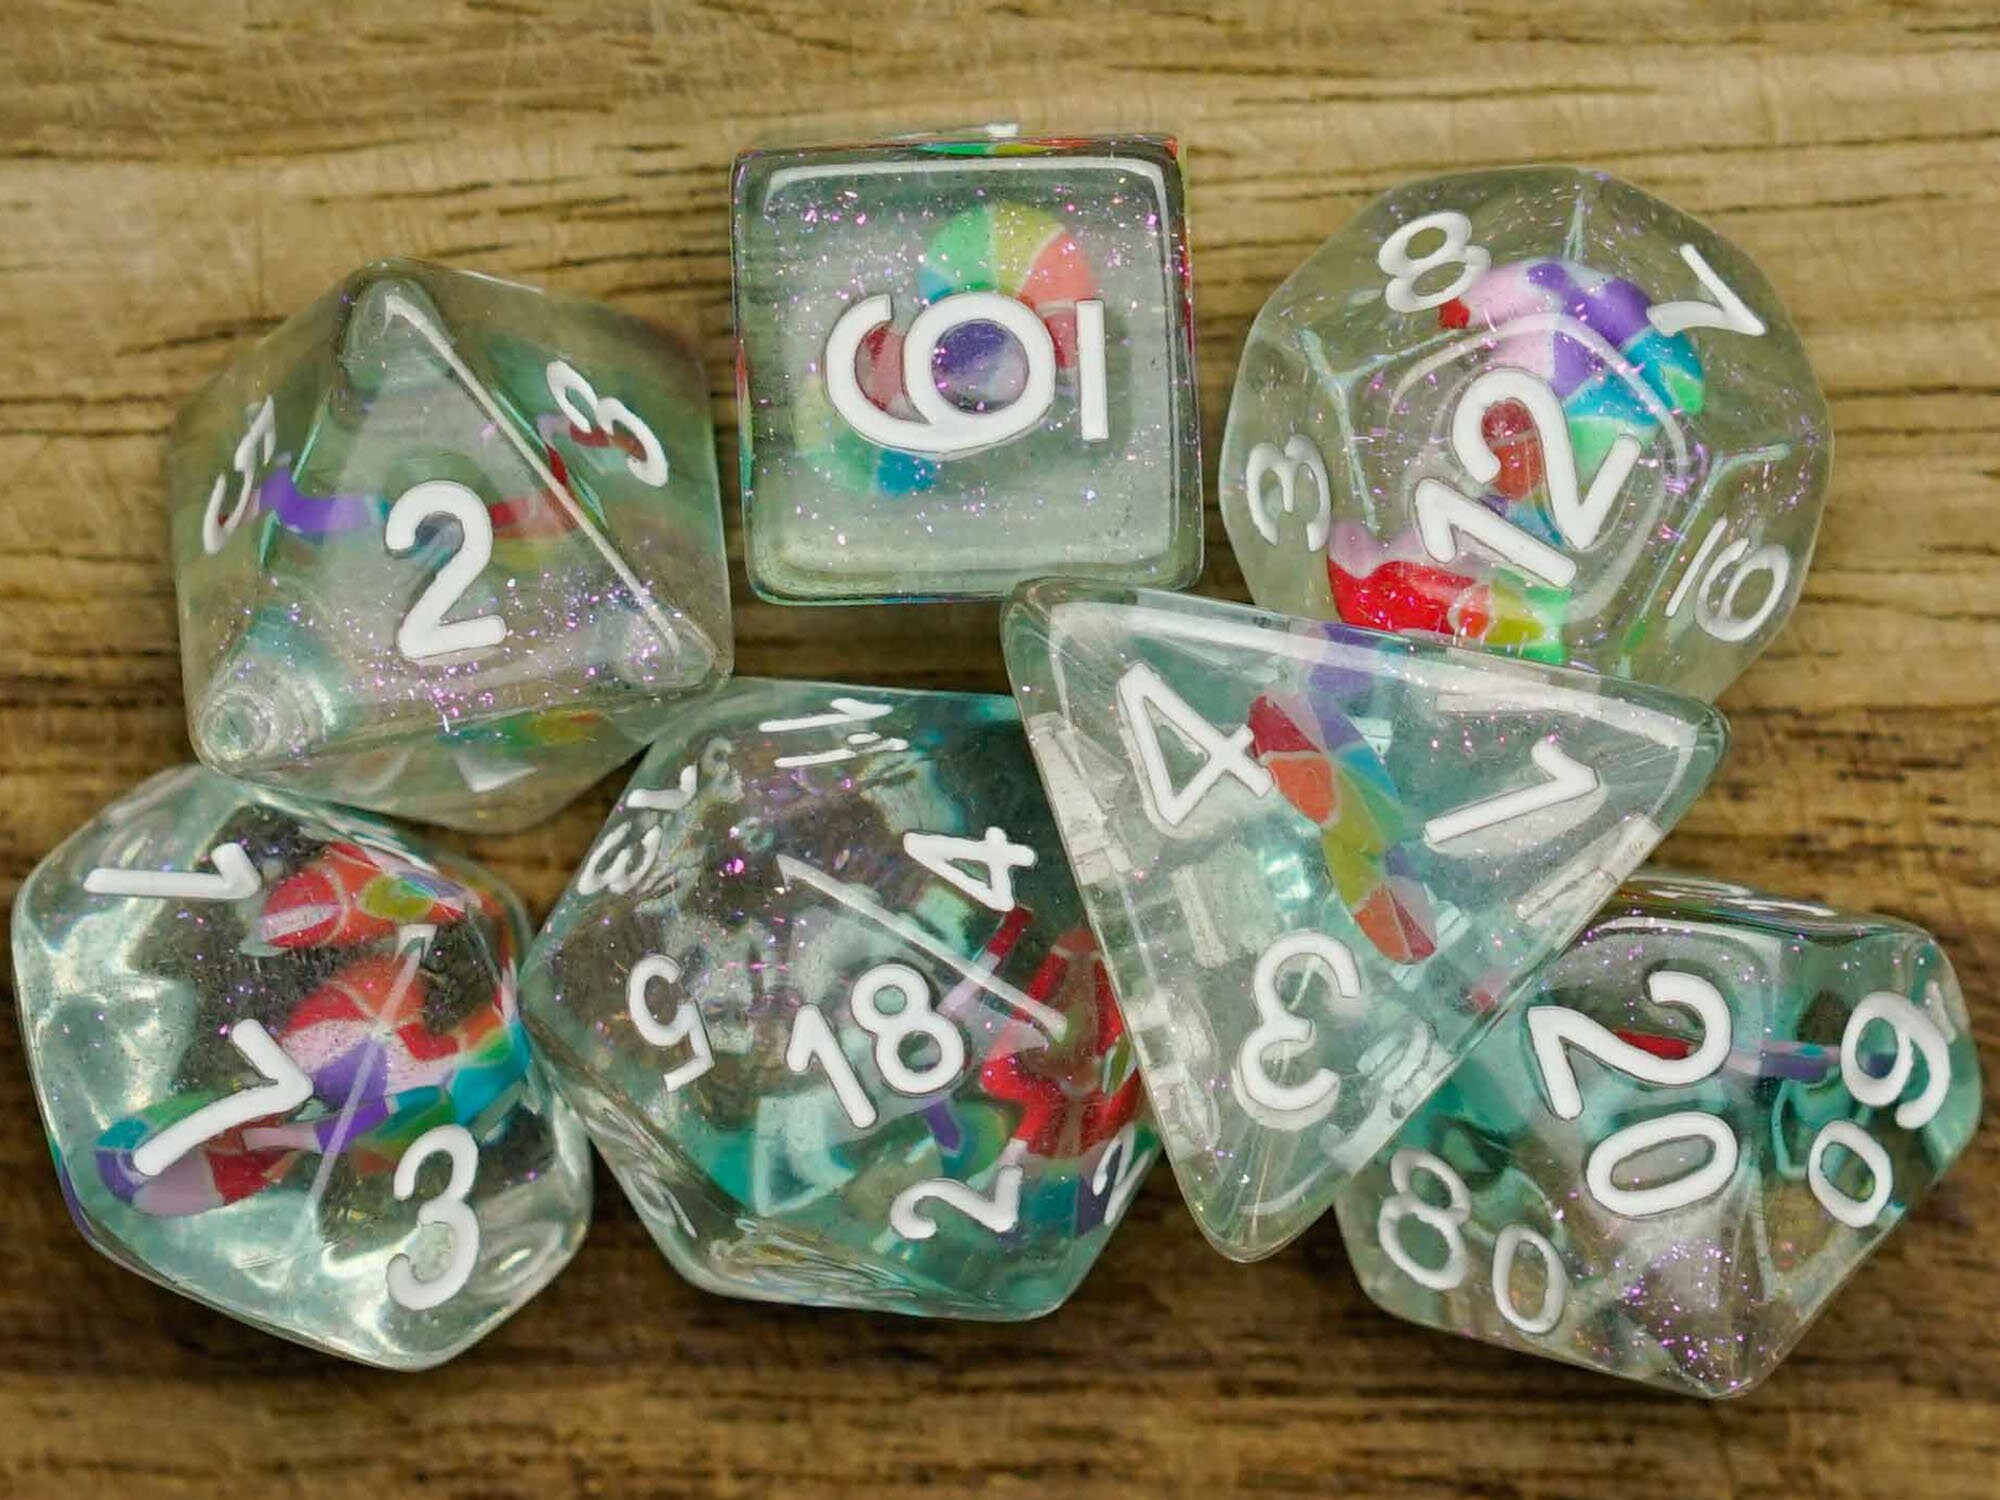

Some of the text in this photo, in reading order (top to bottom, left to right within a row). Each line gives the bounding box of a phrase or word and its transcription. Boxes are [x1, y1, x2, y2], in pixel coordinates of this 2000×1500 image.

[1379, 211, 1491, 313] 8
[546, 360, 669, 487] 3
[1246, 434, 1331, 552] 3
[1414, 368, 1642, 588] 12
[384, 480, 506, 660] 2
[1117, 662, 1273, 828] 4
[1424, 738, 1603, 846] 1
[903, 826, 1038, 912] 4
[134, 1018, 313, 1176] 7
[628, 955, 715, 1093] 5
[786, 963, 965, 1129] 18
[1237, 931, 1360, 1114] 3
[1526, 970, 1738, 1217] 20
[386, 1125, 480, 1310] 3
[891, 1165, 1024, 1239] 2
[1377, 1147, 1569, 1334] 80
